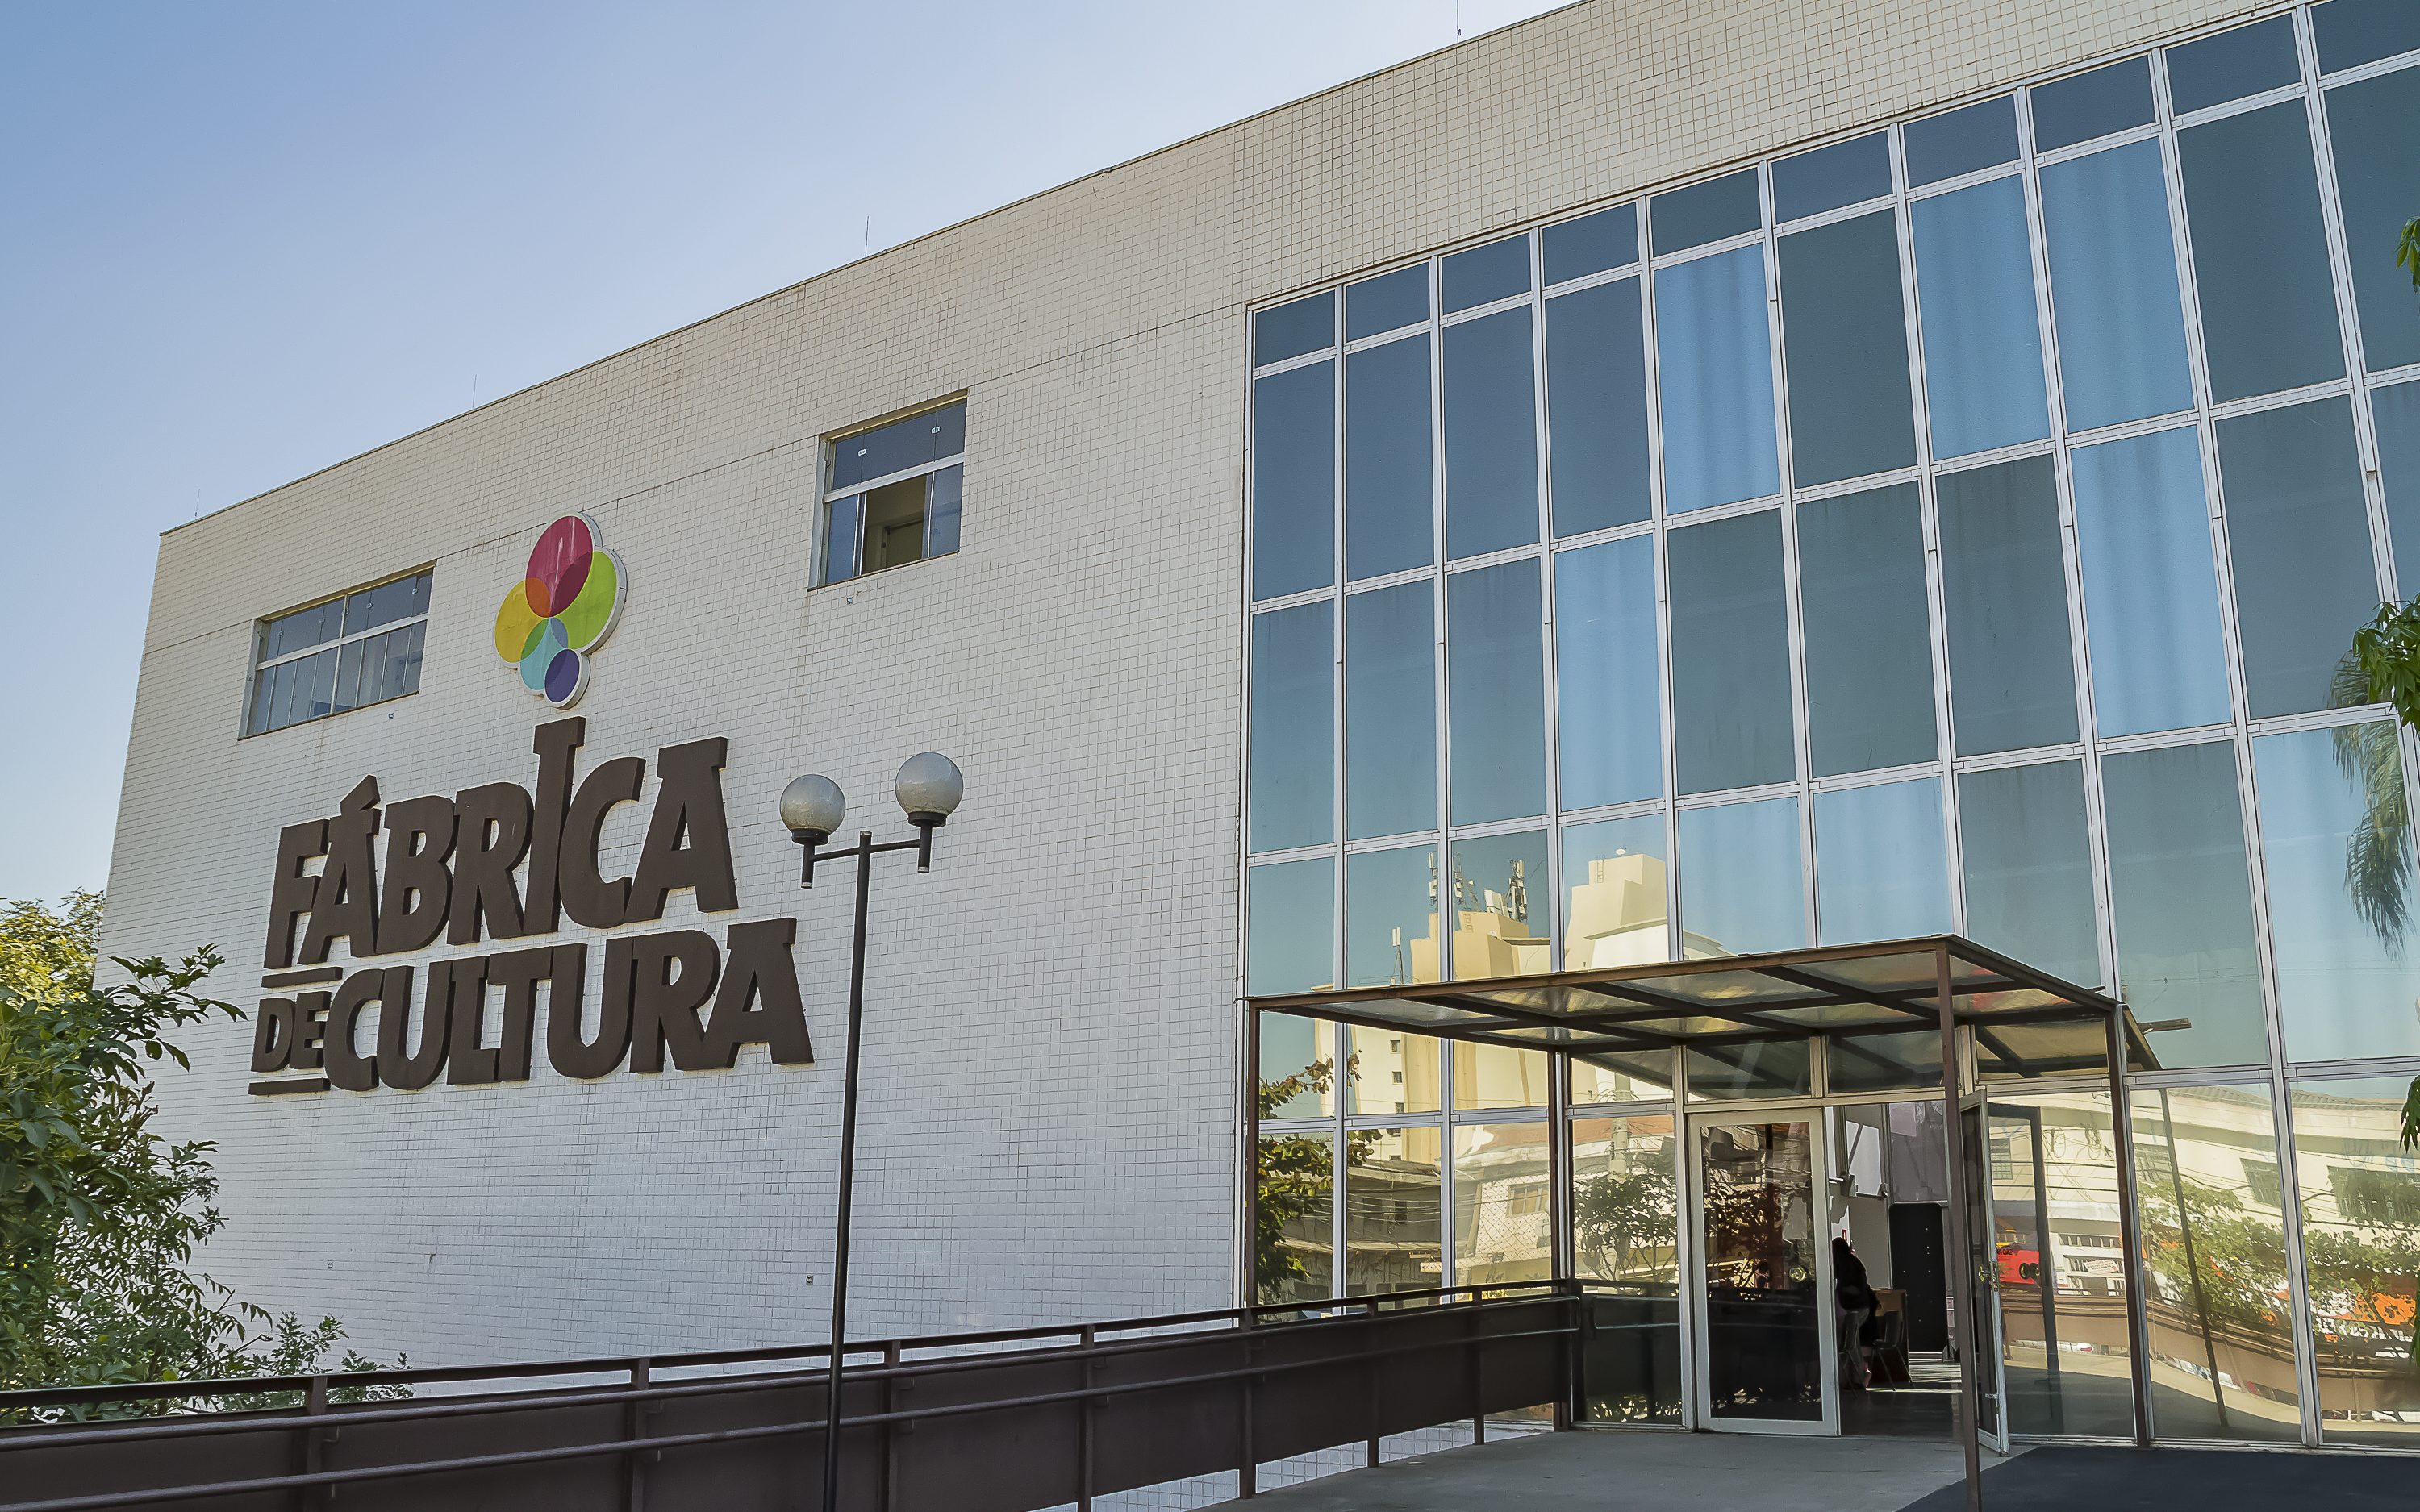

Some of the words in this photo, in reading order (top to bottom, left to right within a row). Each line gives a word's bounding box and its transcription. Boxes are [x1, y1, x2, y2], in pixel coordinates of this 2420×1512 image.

[264, 716, 739, 969] FÁBRICA
[251, 992, 332, 1073] DE
[323, 917, 815, 1090] CULTURA
